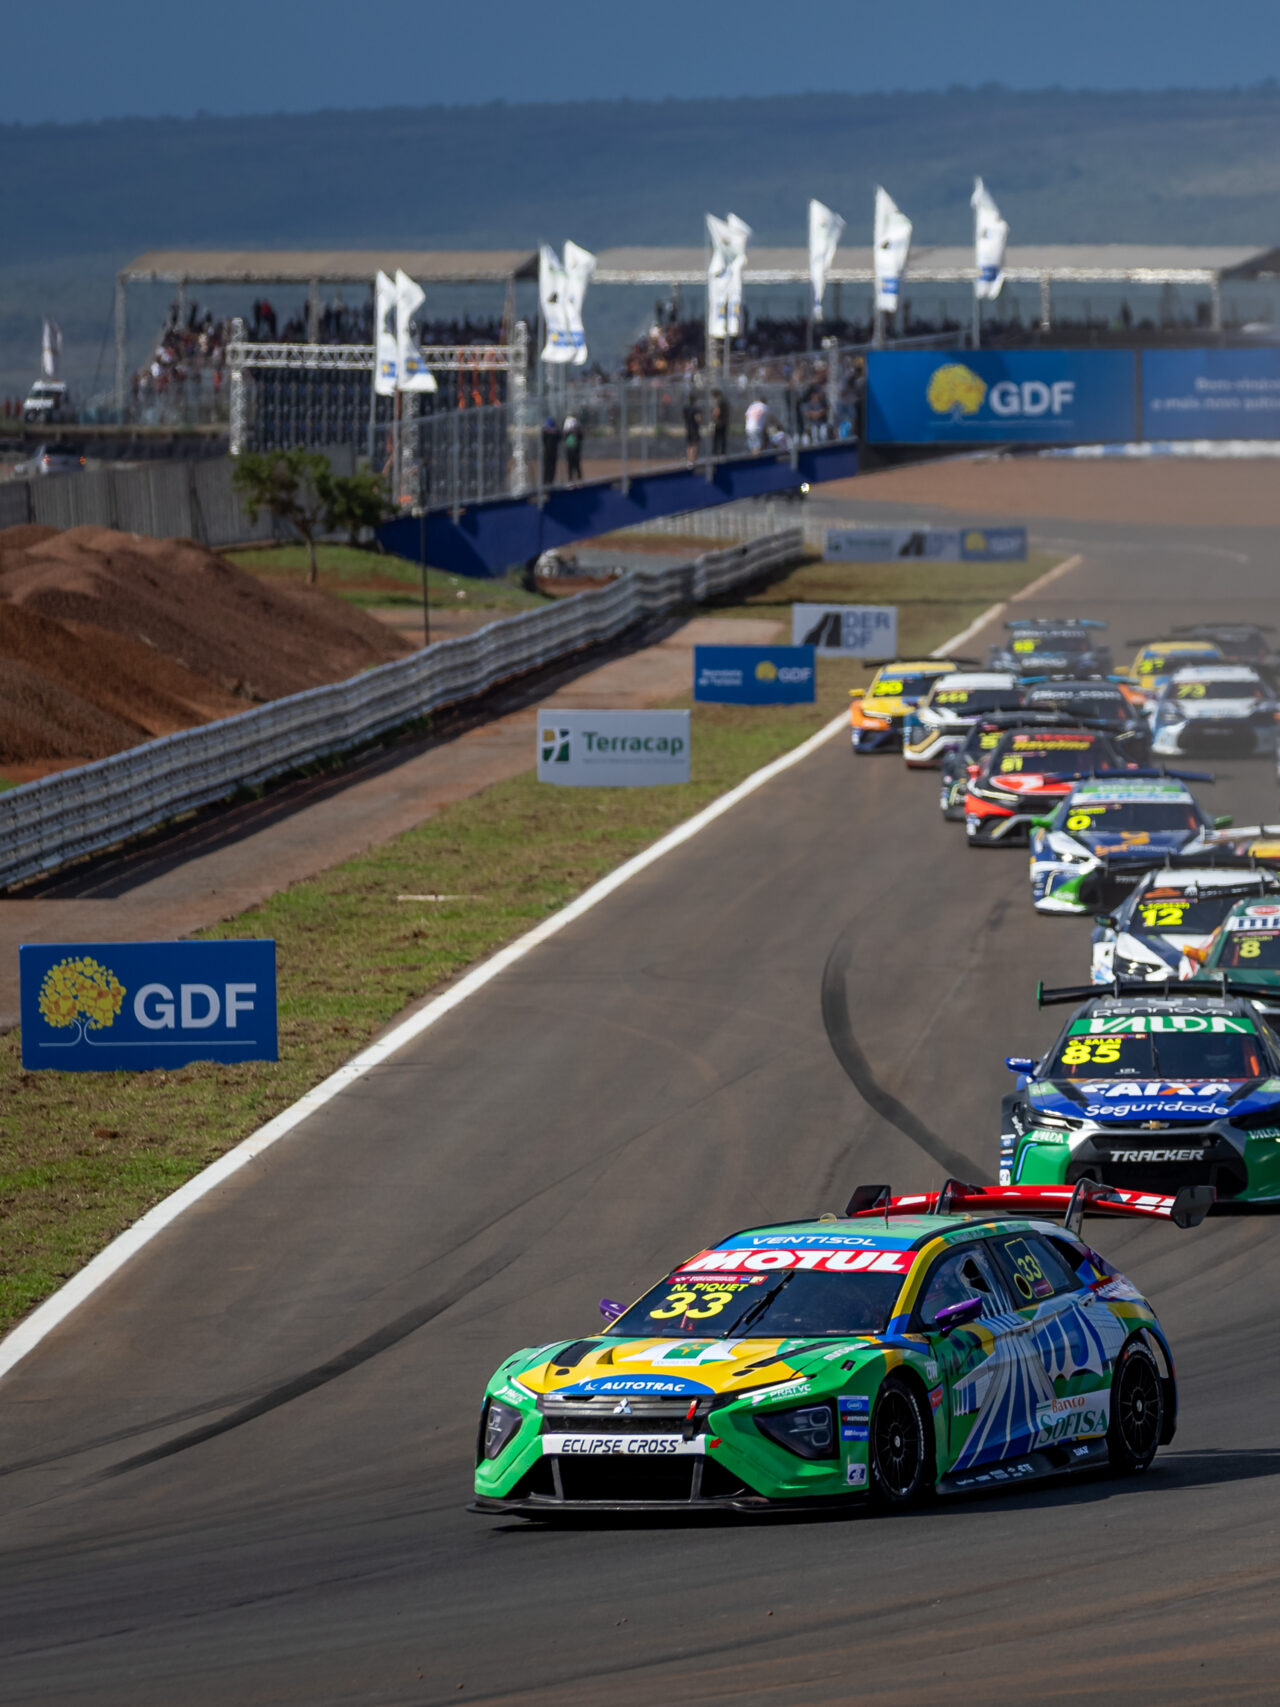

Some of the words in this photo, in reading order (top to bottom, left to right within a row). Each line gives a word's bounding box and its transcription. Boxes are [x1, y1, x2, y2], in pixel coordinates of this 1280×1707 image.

[990, 381, 1076, 415] GDF
[843, 611, 891, 630] DER
[843, 630, 873, 649] DF
[778, 666, 813, 684] GDF
[580, 731, 684, 756] Terracap
[1142, 908, 1183, 926] 12
[1239, 940, 1261, 959] 8
[133, 982, 257, 1030] GDF
[1089, 1016, 1247, 1034] VALDA
[1084, 1038, 1122, 1046] SALAS
[1061, 1045, 1121, 1065] 85
[1080, 1082, 1233, 1097] CAIXA
[1084, 1101, 1230, 1117] Seguridade
[1109, 1149, 1205, 1163] TRACKER
[752, 1236, 877, 1247] VENTISOL
[683, 1250, 906, 1271] MOTUL
[1017, 1255, 1043, 1283] 33
[671, 1283, 688, 1292] N.
[692, 1283, 749, 1292] PIQUET
[650, 1292, 733, 1319] 33
[599, 1381, 686, 1393] AUTOTRAC
[1051, 1396, 1087, 1415] Banco
[561, 1439, 621, 1454] ECLIPSE
[626, 1439, 679, 1454] CROSS
